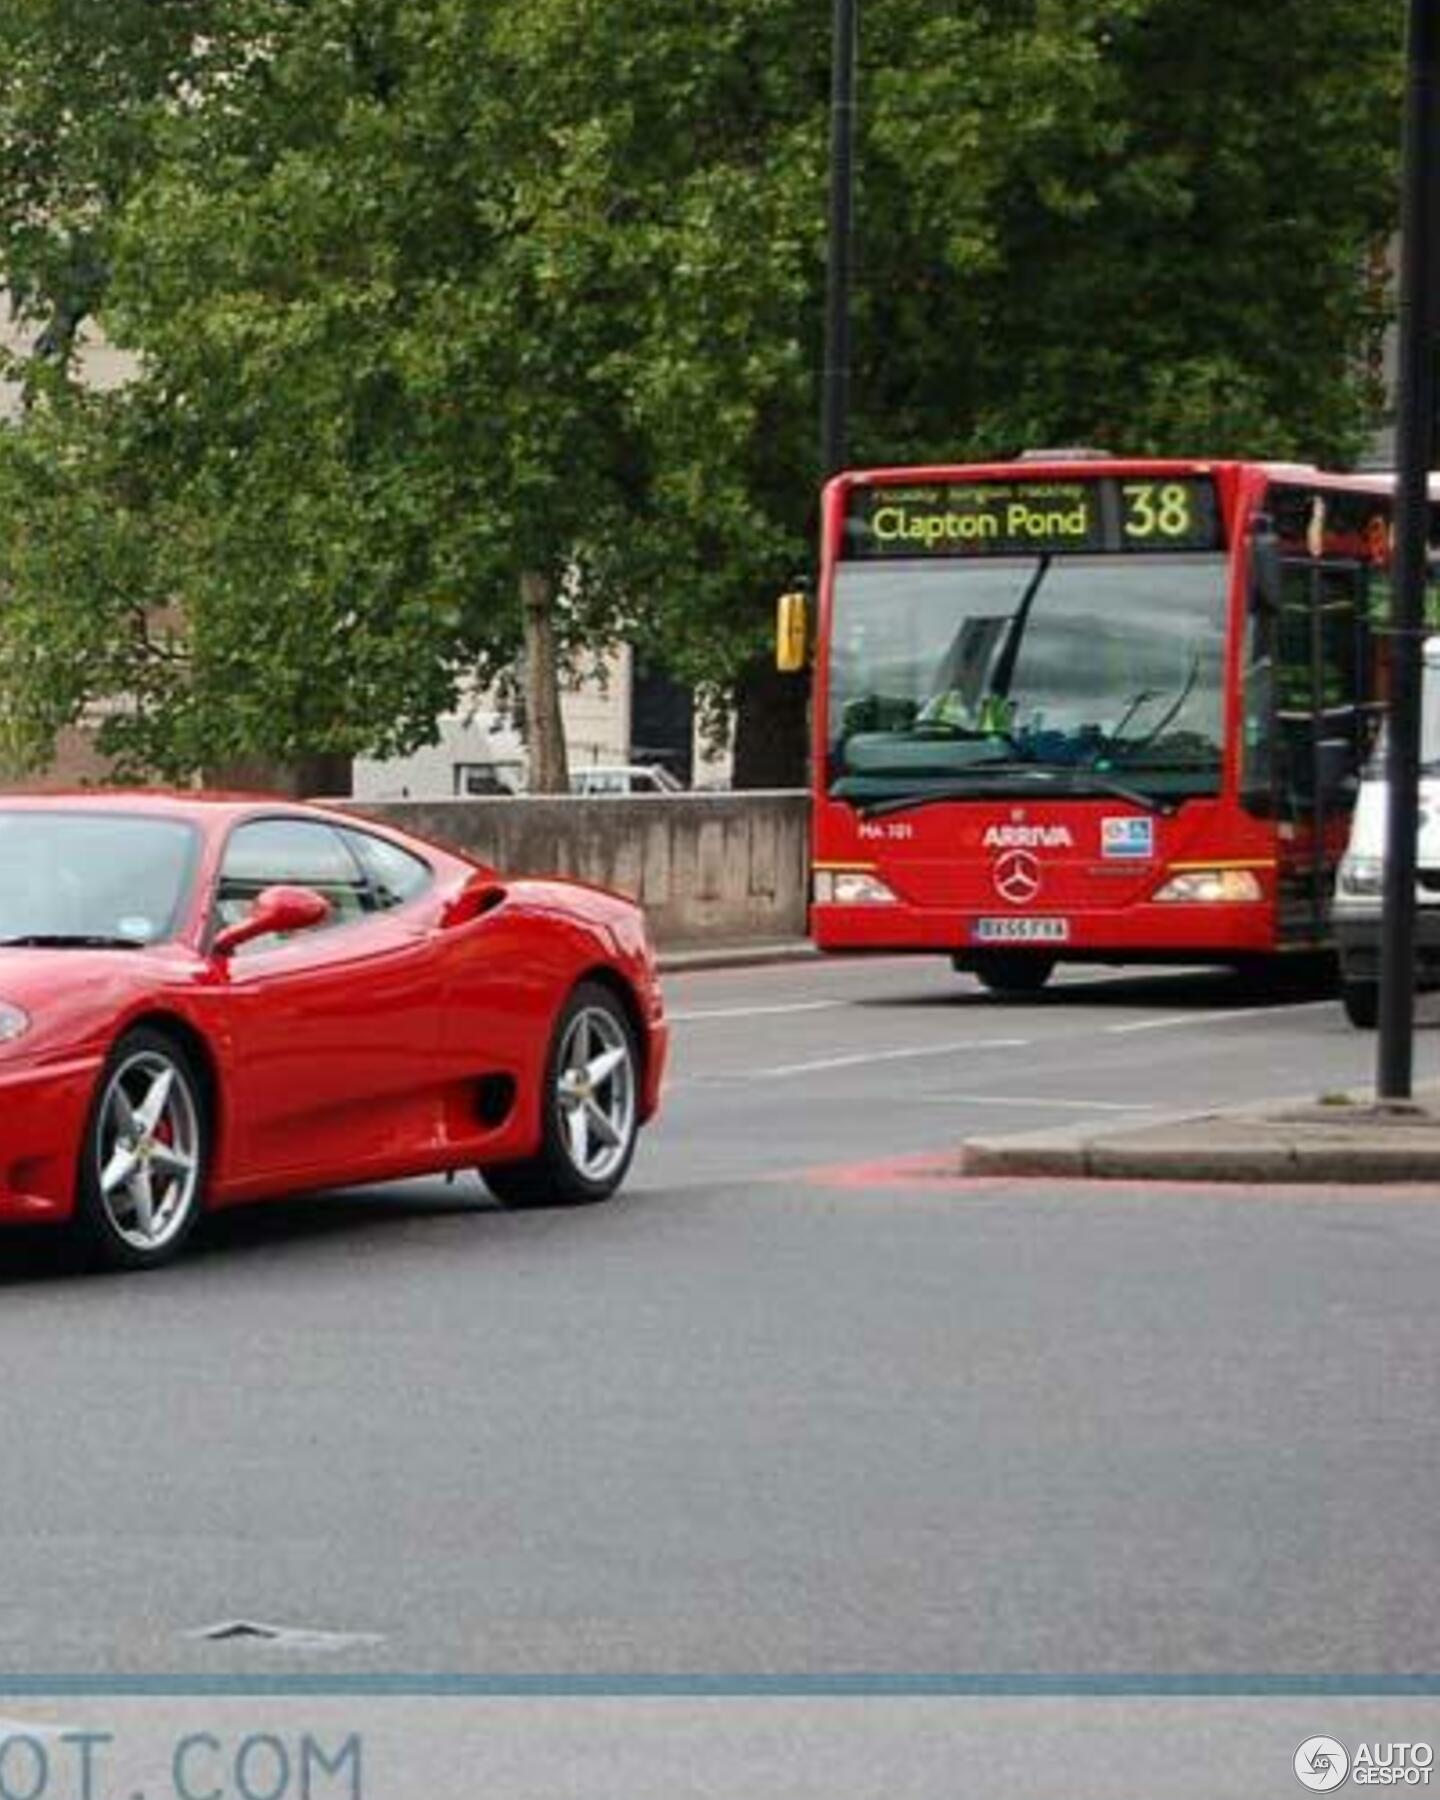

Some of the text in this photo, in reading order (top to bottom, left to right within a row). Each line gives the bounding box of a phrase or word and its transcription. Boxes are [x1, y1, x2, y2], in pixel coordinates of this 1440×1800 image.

[872, 504, 1087, 547] Clapton Pond
[1122, 485, 1188, 537] 38
[982, 825, 1073, 848] ARRIVA
